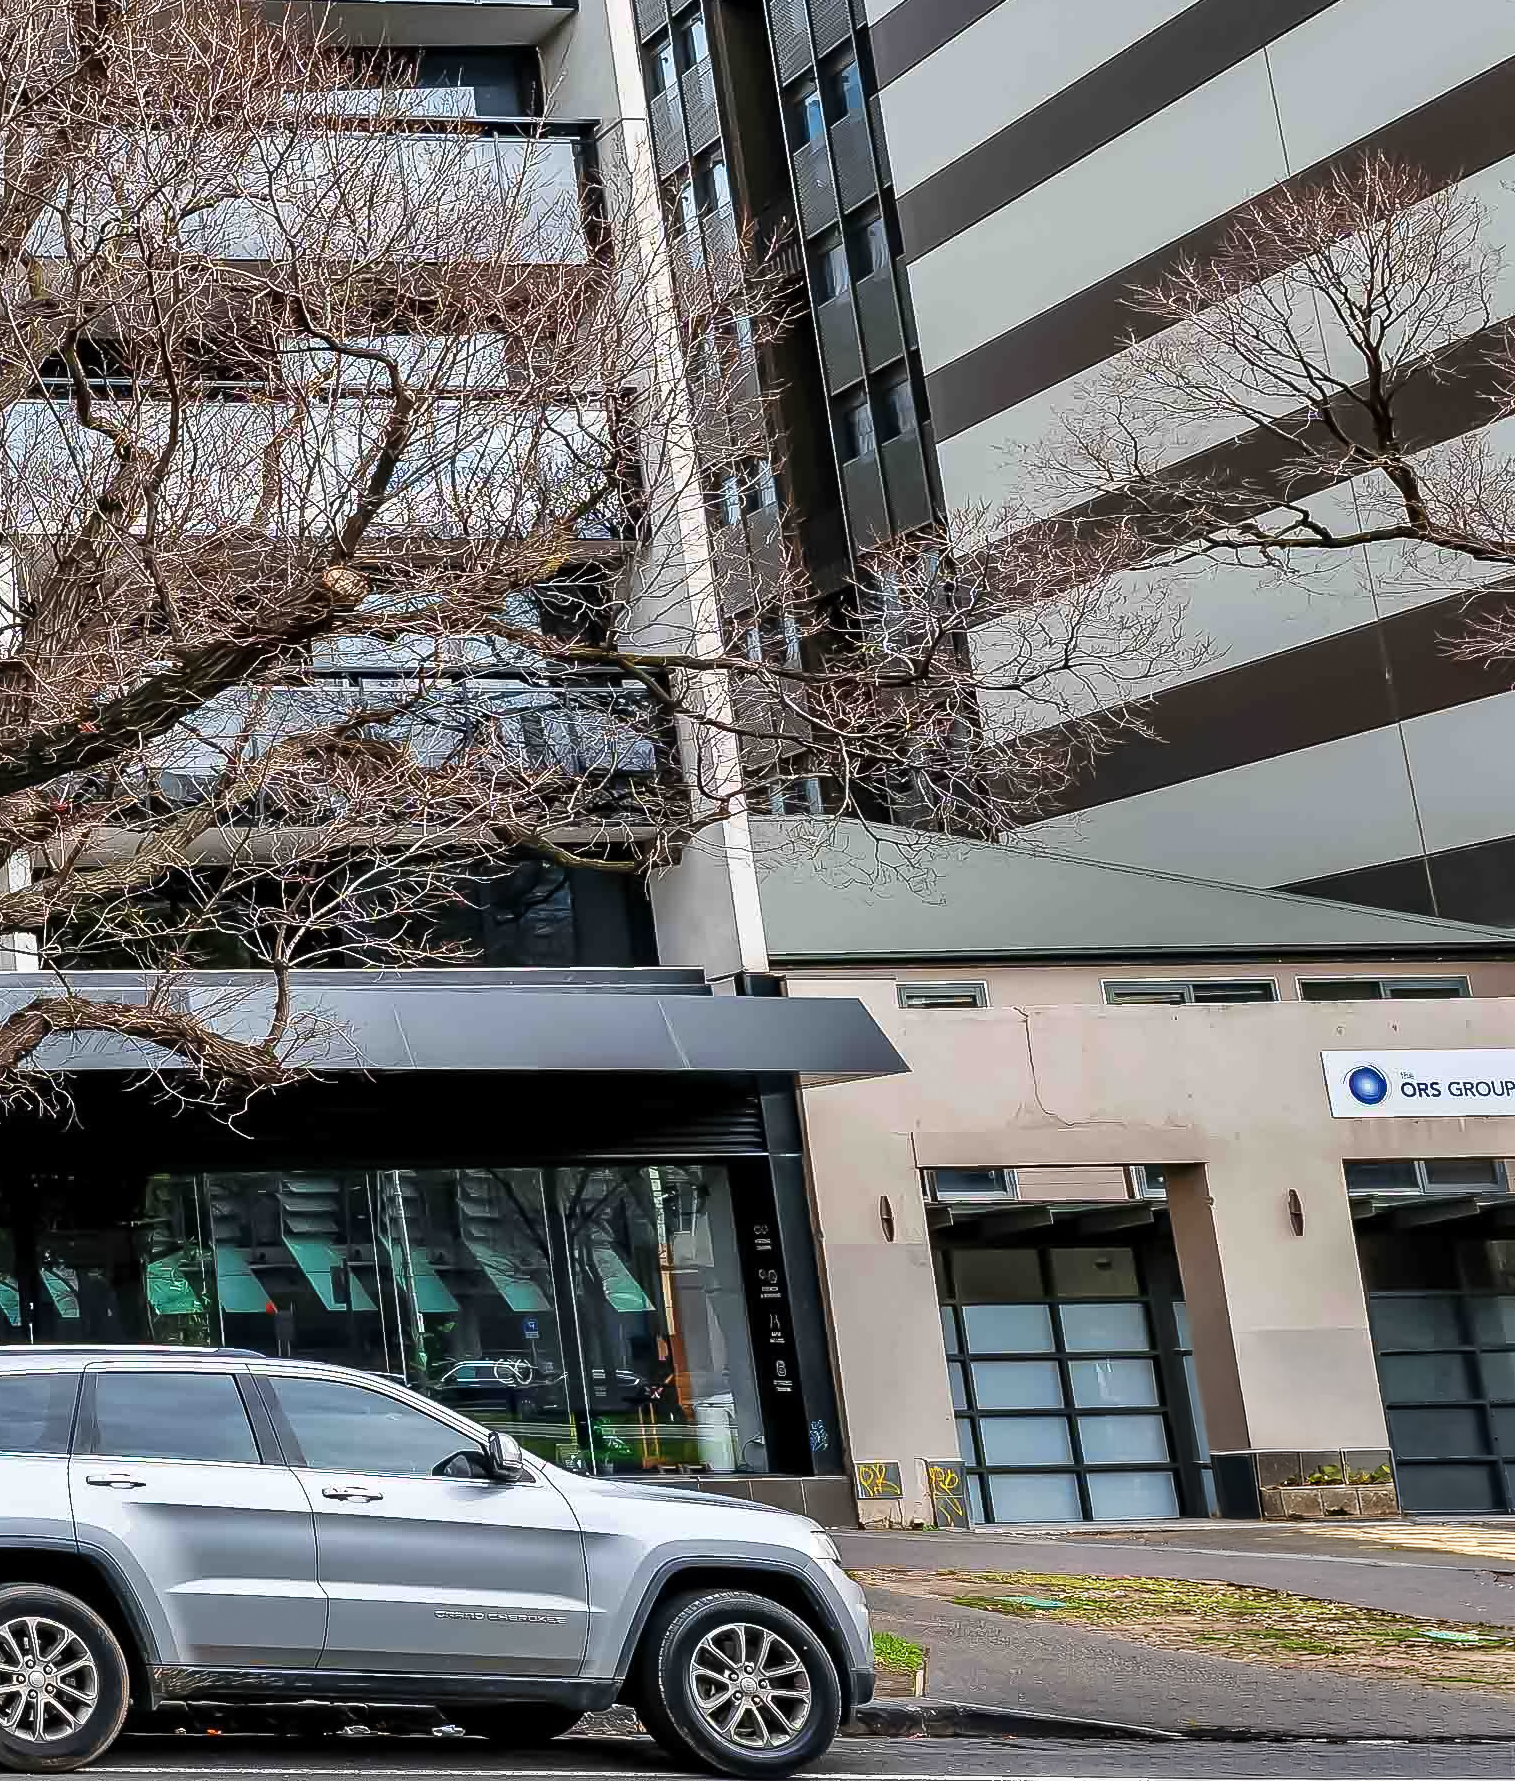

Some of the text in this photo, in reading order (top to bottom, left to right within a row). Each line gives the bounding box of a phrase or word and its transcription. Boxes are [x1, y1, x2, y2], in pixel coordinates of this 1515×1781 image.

[1400, 1080, 1515, 1098] ORS GROUP
[433, 1610, 568, 1625] GRAND CHEROKEE
